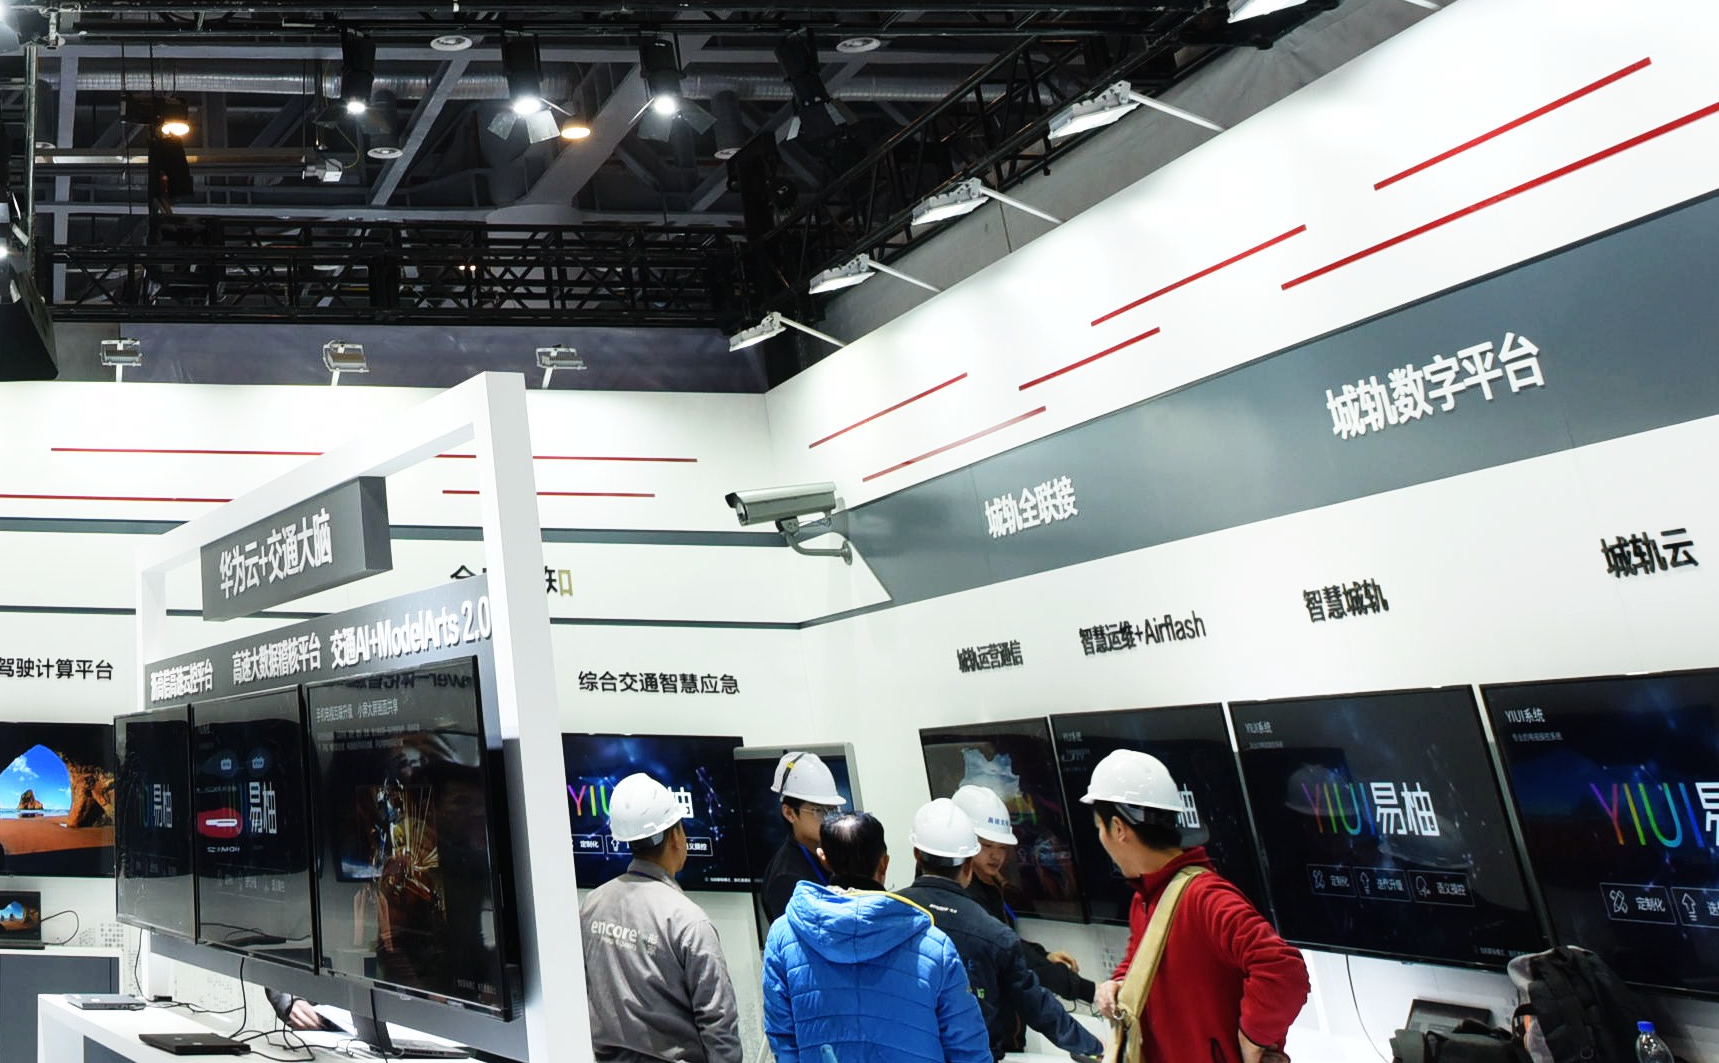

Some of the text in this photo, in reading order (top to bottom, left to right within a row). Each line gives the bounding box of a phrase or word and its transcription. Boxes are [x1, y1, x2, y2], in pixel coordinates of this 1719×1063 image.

[1326, 332, 1546, 440] 城轨数字平台
[984, 475, 1079, 539] 城轨全联接
[218, 507, 333, 601] 华为云+交通大脑
[1600, 527, 1700, 579] 城轨云
[1302, 578, 1390, 624] 智慧城轨
[329, 595, 493, 670] 交通AI+ModelArts 2.0
[956, 639, 1024, 674] 城轨运营通信
[1078, 610, 1207, 656] 智慧运维+Airflash
[231, 631, 322, 686] 高速大数据稽核平台
[578, 670, 740, 695] 综合交通智慧应急
[1504, 707, 1546, 723] YIUI系统
[590, 920, 638, 943] encore
